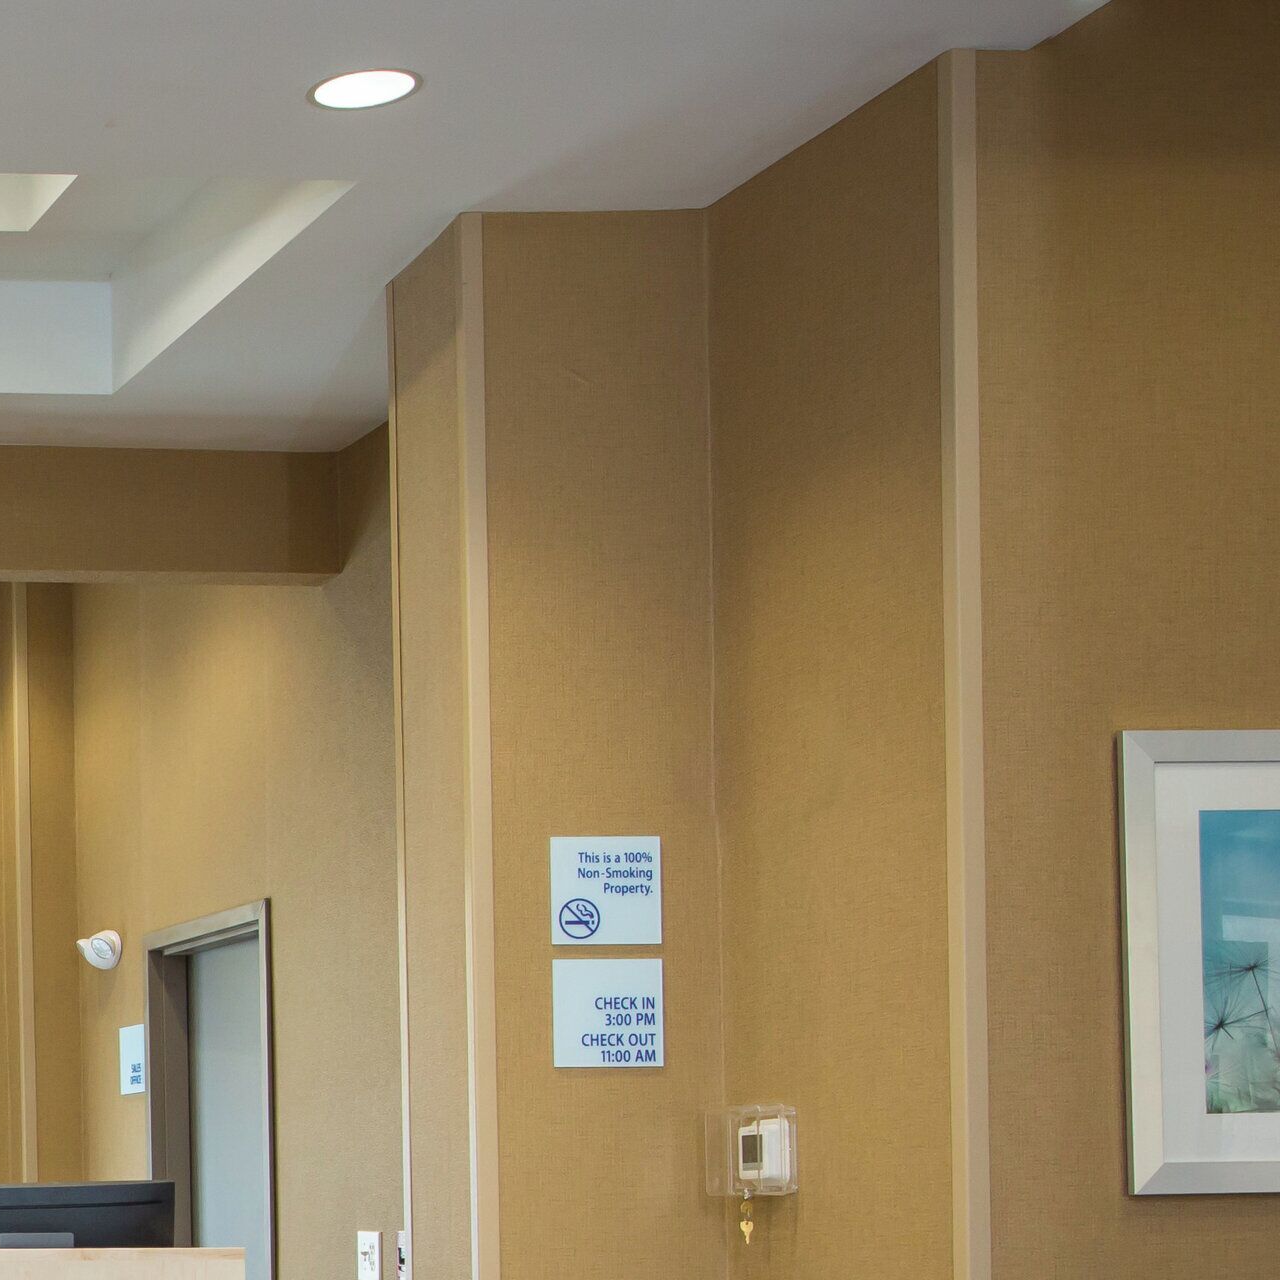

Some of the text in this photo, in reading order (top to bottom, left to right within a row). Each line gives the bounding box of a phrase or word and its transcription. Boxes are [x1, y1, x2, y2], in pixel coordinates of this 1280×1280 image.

[578, 852, 652, 863] This is a 100%
[604, 883, 653, 896] Property.
[595, 997, 655, 1010] CHECK IN
[605, 1013, 656, 1026] 3:00 PM
[582, 1034, 656, 1046] CHECK OUT
[601, 1050, 656, 1062] 11:00 AM
